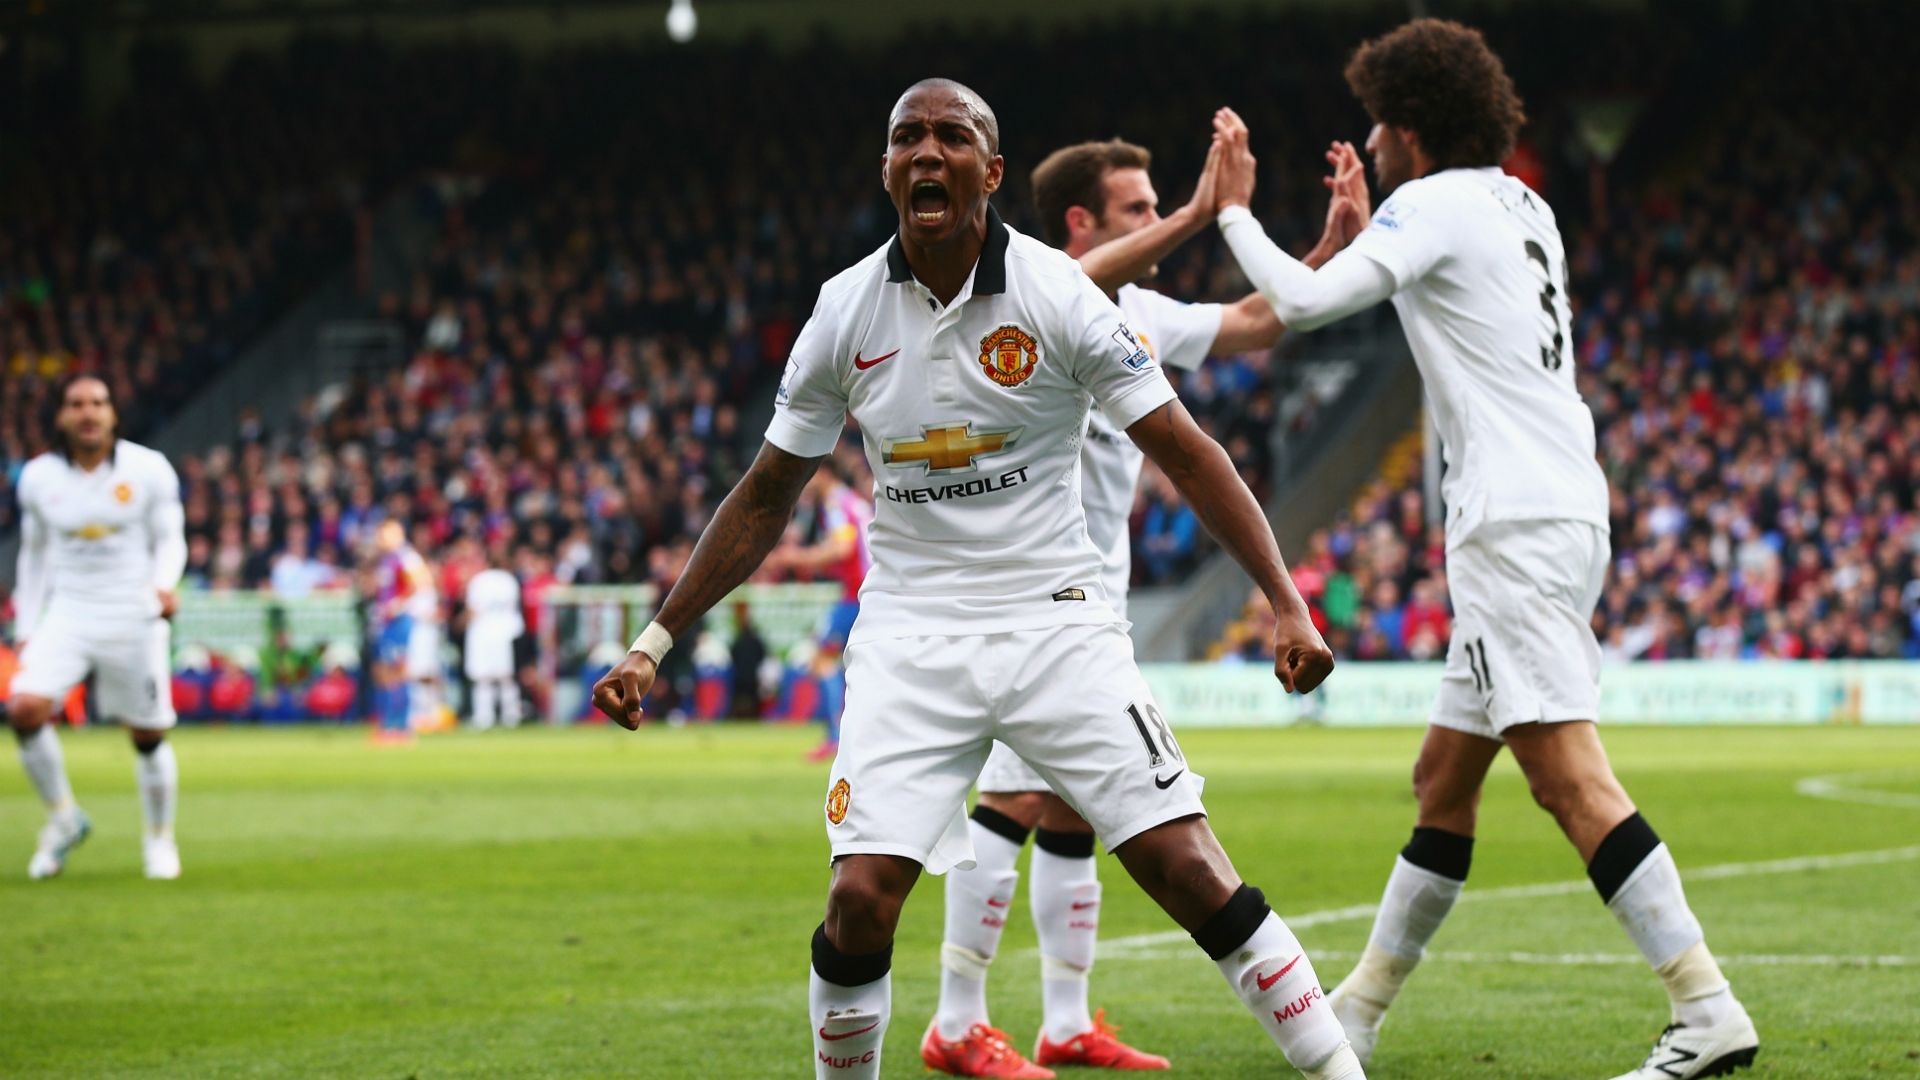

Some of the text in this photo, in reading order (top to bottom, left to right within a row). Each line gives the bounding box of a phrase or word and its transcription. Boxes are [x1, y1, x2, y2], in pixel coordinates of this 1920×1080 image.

[993, 371, 1026, 382] UNITED
[886, 466, 1028, 503] CHEVROLET
[1123, 700, 1184, 769] 18
[1273, 986, 1321, 1024] MUFC
[819, 1050, 875, 1069] MUFC
